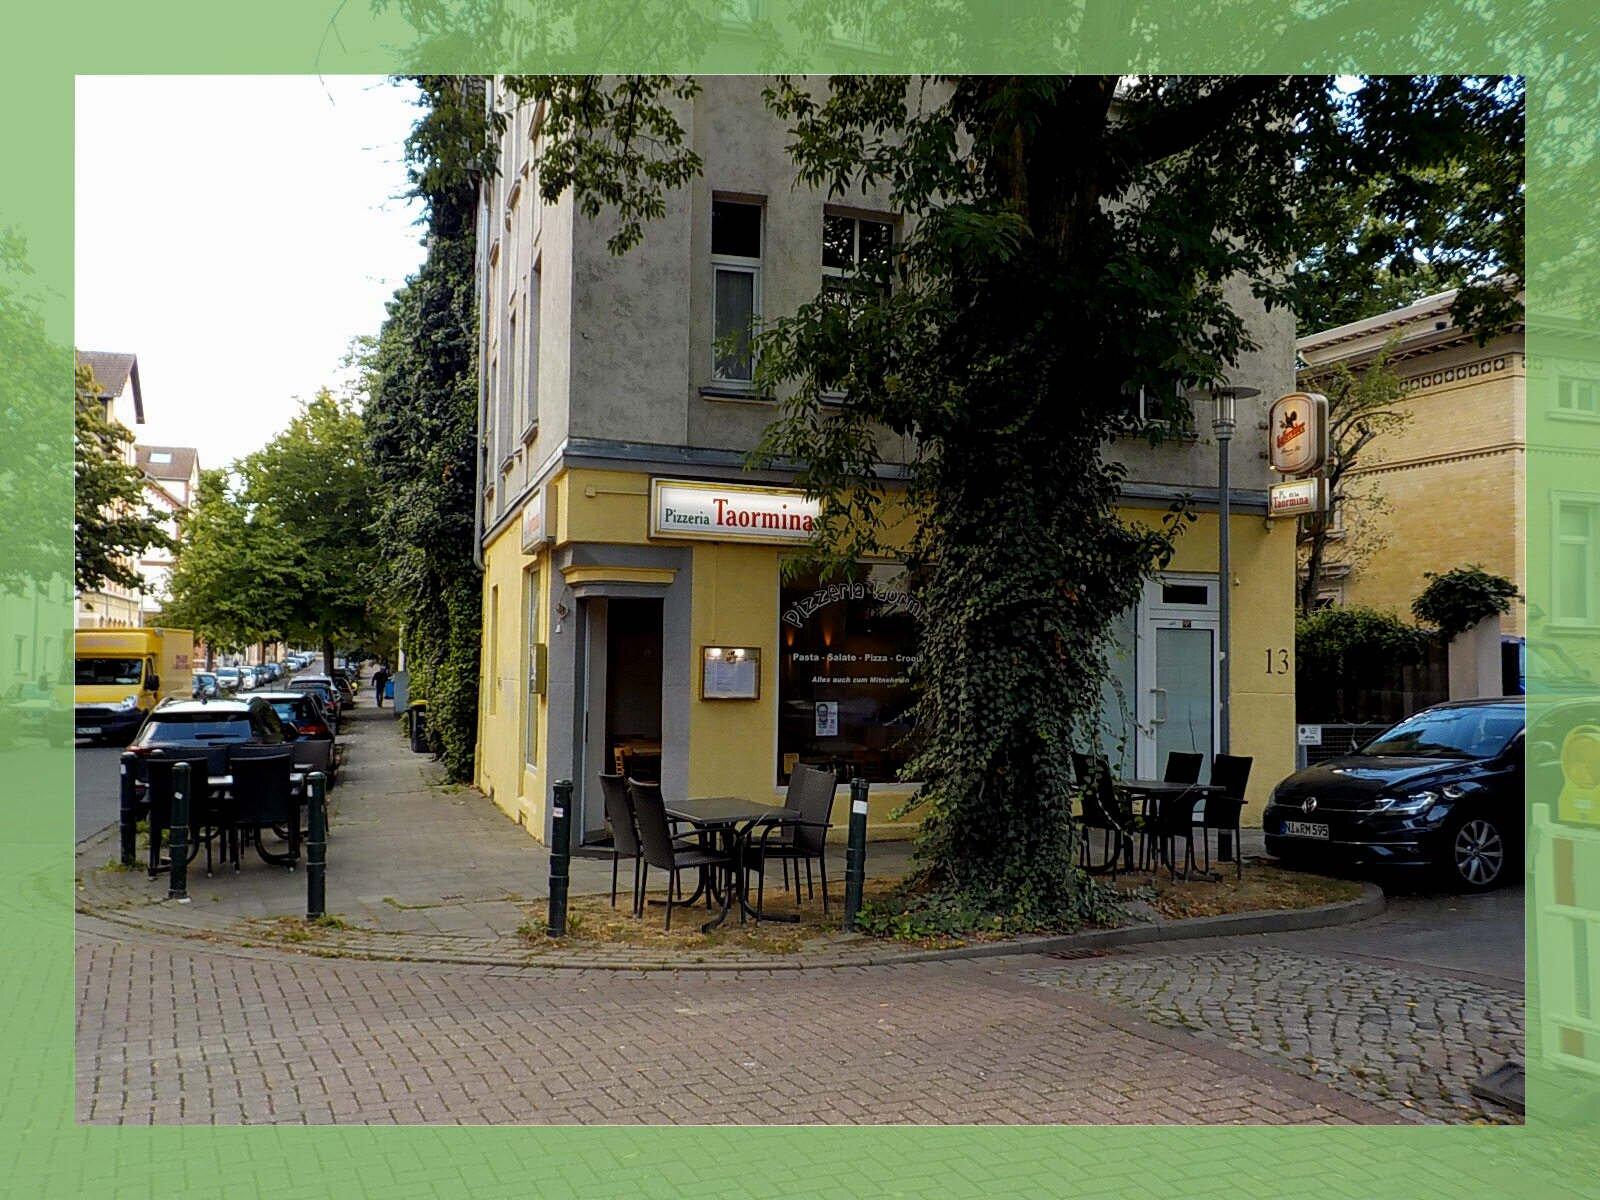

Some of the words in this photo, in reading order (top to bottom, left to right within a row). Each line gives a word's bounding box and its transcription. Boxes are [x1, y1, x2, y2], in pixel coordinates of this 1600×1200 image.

[1273, 497, 1309, 508] Taormina
[665, 508, 710, 525] Pizzeria
[713, 499, 814, 531] Taormina
[783, 583, 865, 629] Pizzeria
[793, 652, 820, 662] Pasta
[864, 653, 888, 662] Pizza
[1265, 648, 1289, 675] 13
[812, 676, 831, 684] Alles
[832, 675, 851, 684] auch
[852, 676, 868, 684] zum
